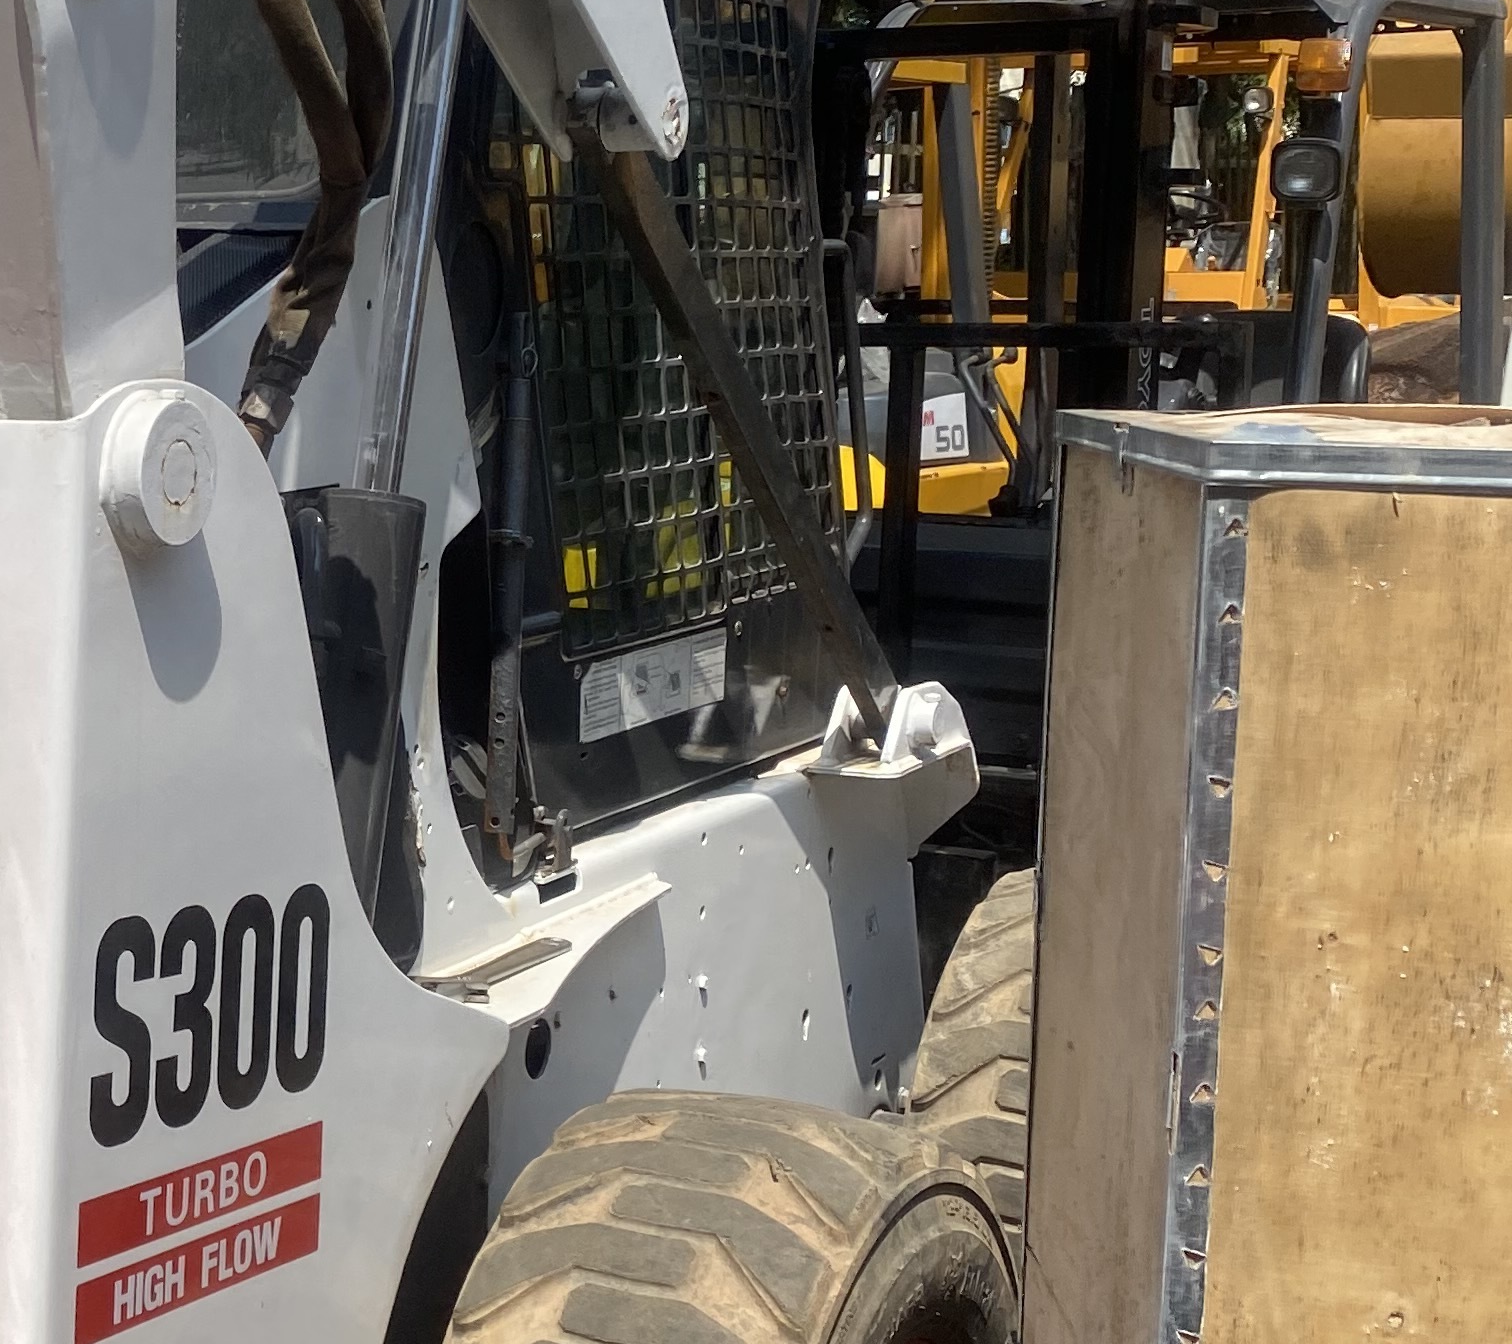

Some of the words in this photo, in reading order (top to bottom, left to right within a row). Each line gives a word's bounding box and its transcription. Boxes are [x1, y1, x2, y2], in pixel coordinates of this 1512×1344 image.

[935, 424, 966, 453] 50
[89, 884, 331, 1147] S300
[139, 1150, 268, 1236] TURBO
[112, 1256, 186, 1325] HIGH
[200, 1216, 283, 1289] FLOW
